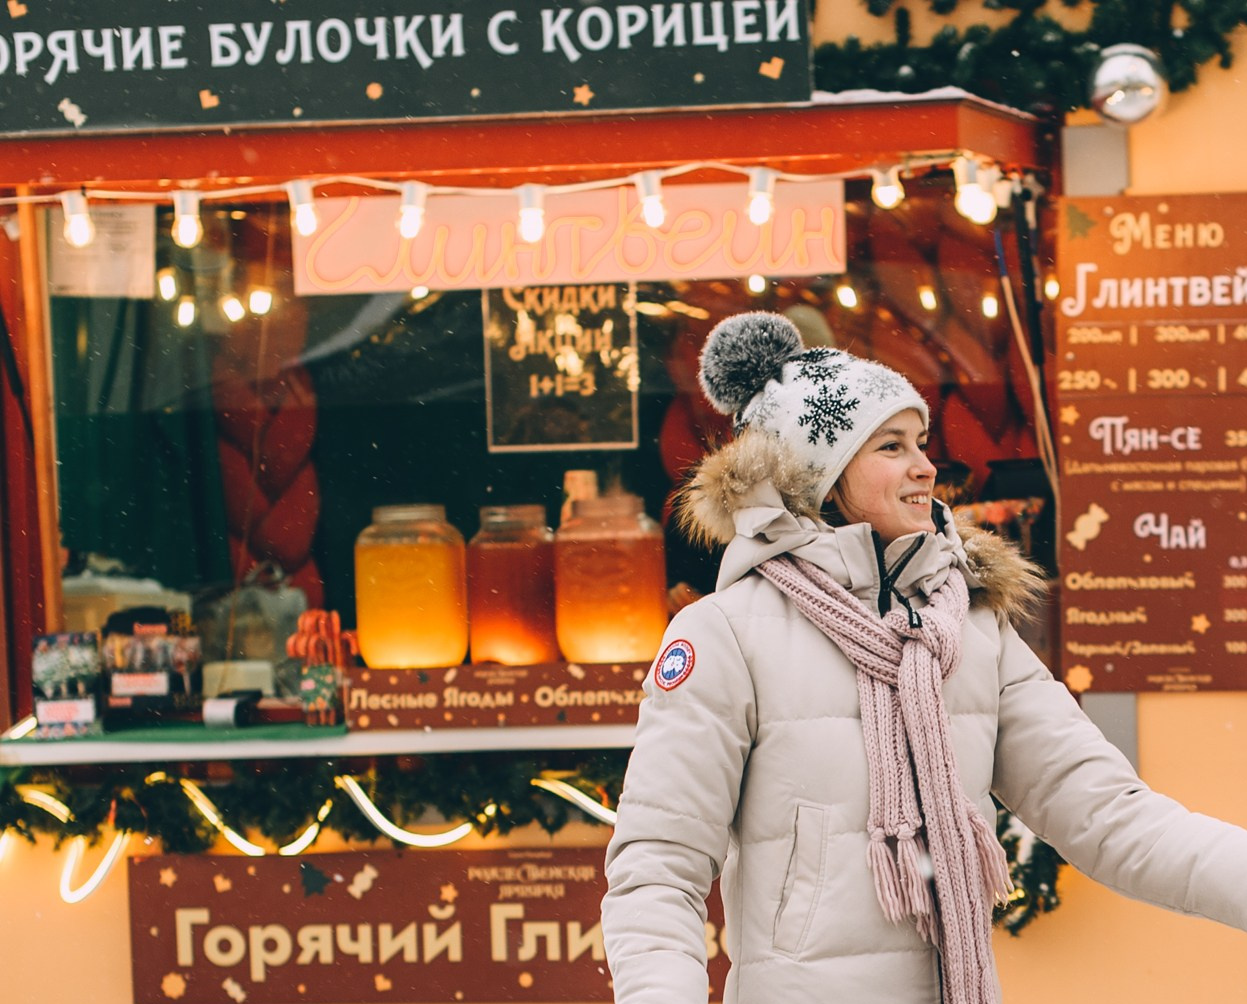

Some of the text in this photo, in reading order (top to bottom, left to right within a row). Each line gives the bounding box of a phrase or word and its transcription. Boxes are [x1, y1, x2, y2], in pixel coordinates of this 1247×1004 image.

[208, 12, 464, 68] БУЛОЧКИ
[487, 10, 519, 55] С
[541, 0, 800, 63] КОРИЦЕЙ
[175, 903, 462, 983] Горячий
